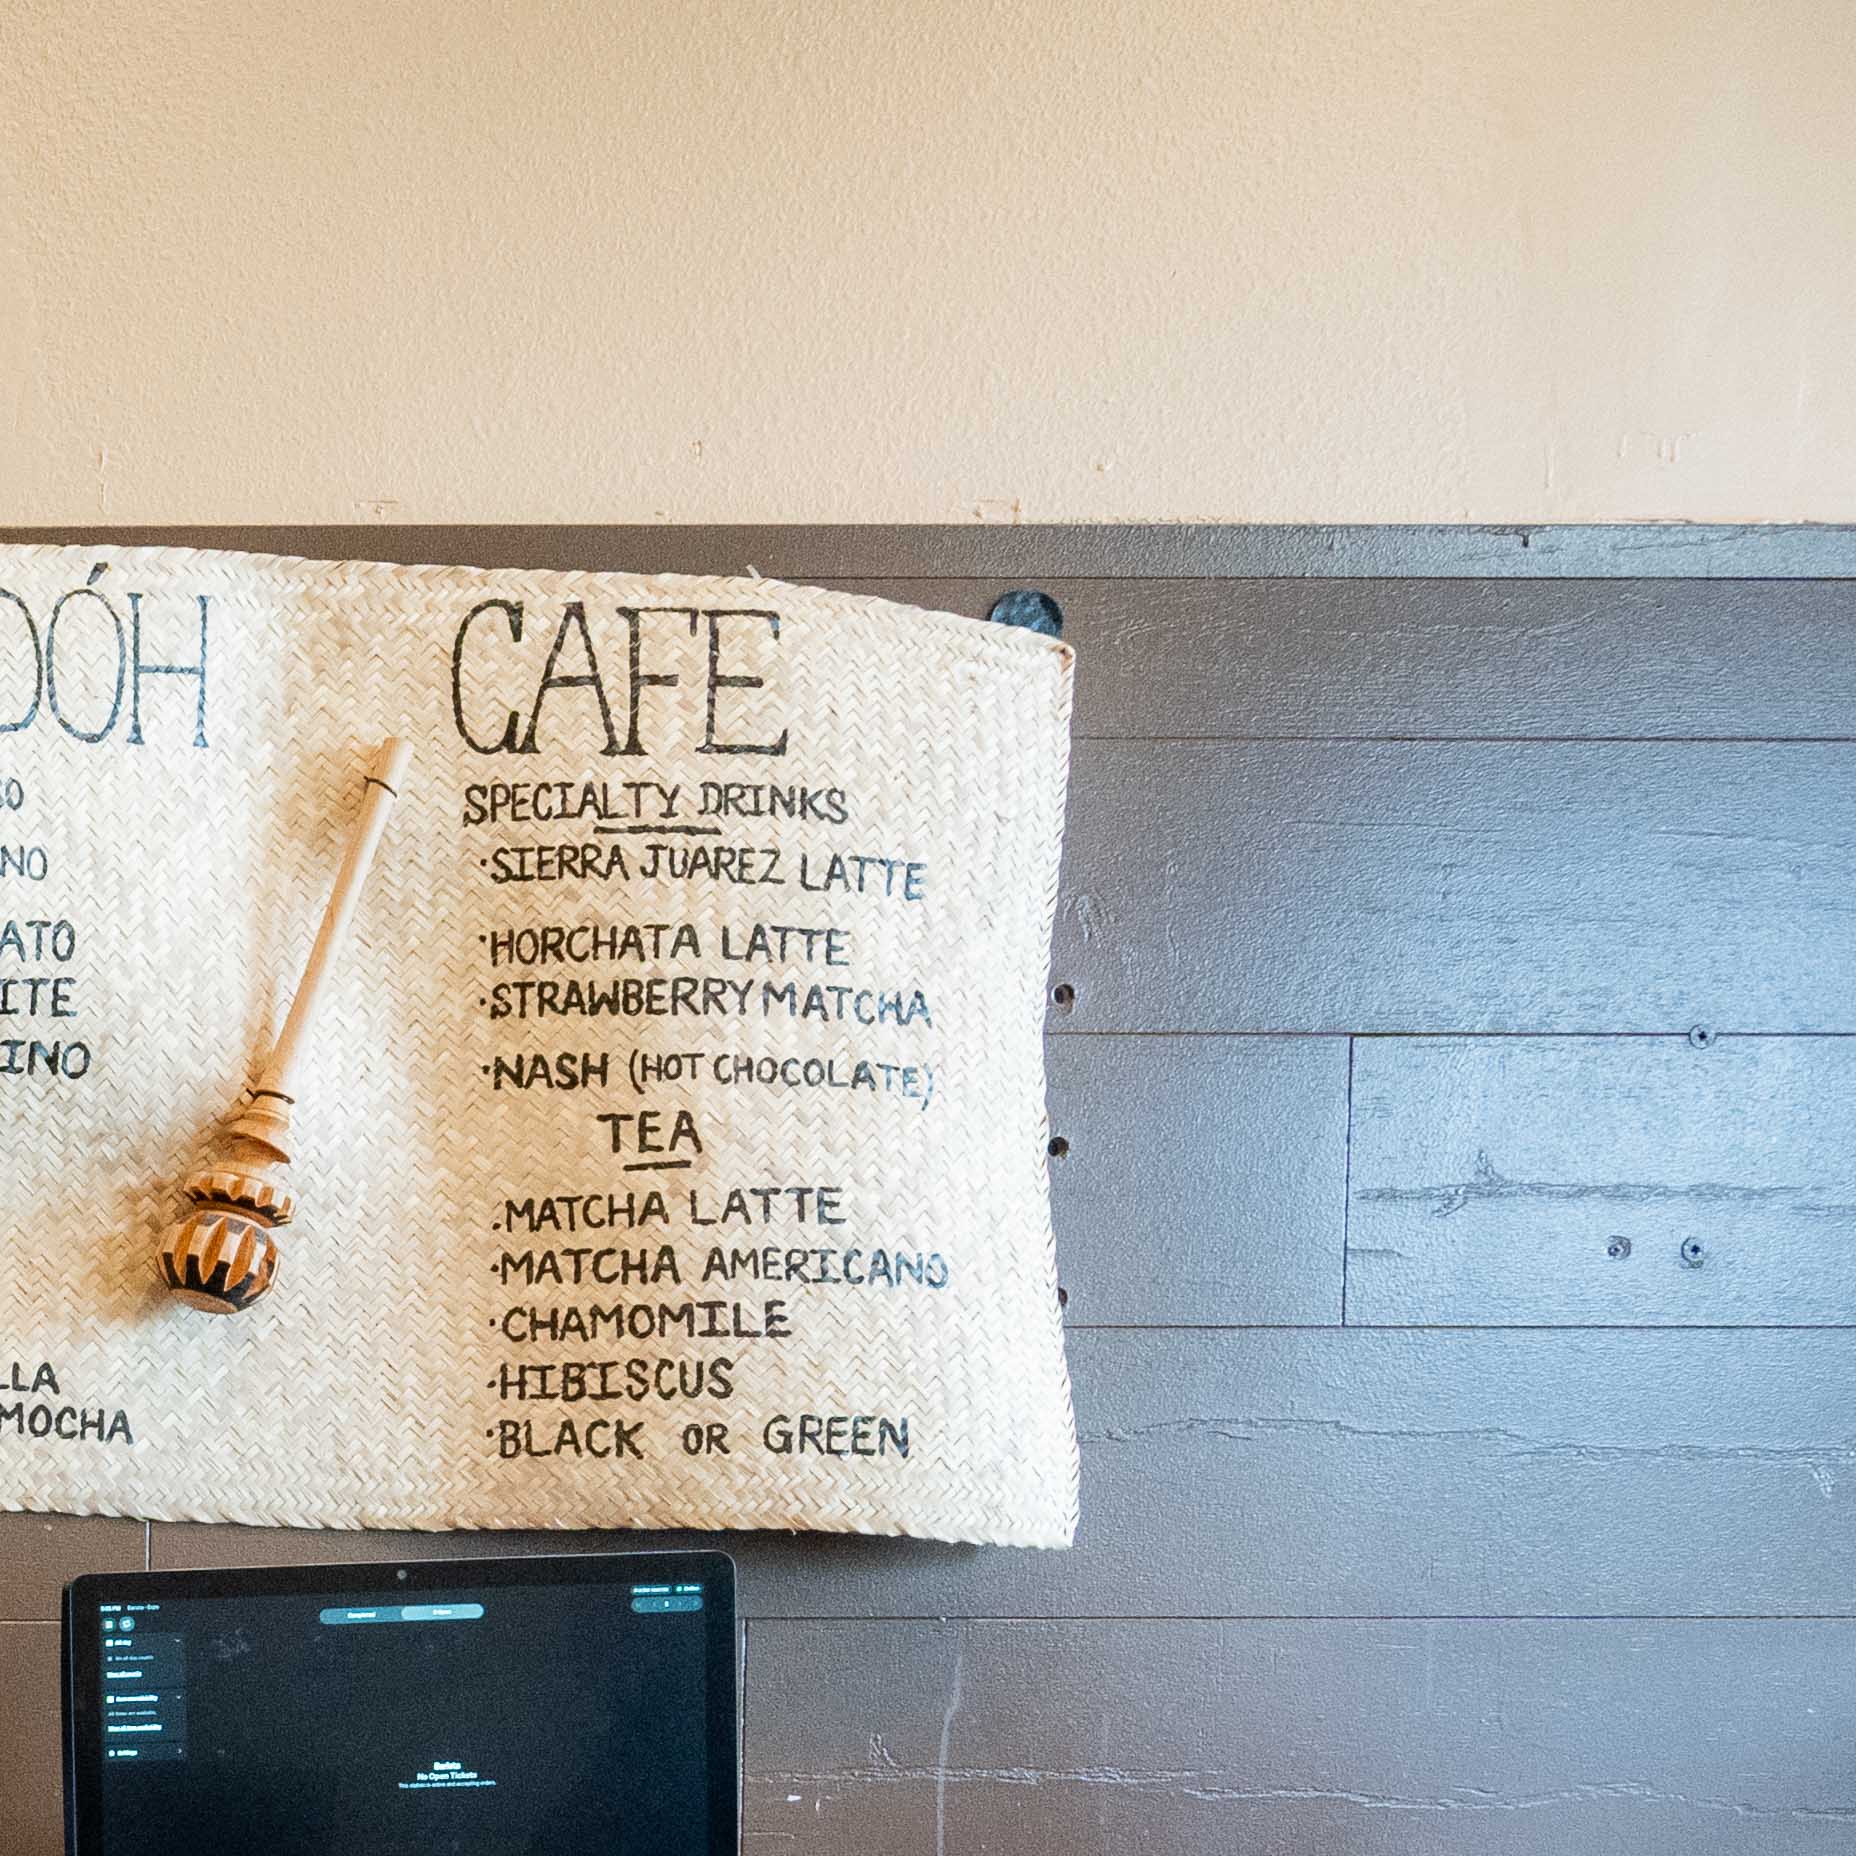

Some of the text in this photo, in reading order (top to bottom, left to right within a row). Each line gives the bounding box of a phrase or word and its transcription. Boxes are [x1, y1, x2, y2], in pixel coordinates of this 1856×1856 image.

[452, 599, 789, 756] CAFE
[463, 781, 849, 827] SPECIALTY DRINKS
[491, 844, 929, 901] SIERRA JUAREZ LATTE
[490, 924, 850, 967] HORCHATA LATTE
[489, 977, 932, 1029] STRAWBERRY MATCHA
[493, 1048, 934, 1111] NASH (HOT CHOCOLATE)
[596, 1110, 703, 1154] TEA
[504, 1187, 847, 1232] MATCHA LATTE
[499, 1245, 950, 1289] MATCHA AMERICANO
[501, 1299, 793, 1342] CHAMOMILE
[499, 1357, 735, 1401] HIBISCUS
[497, 1414, 910, 1460] BLACK OR GREEN
